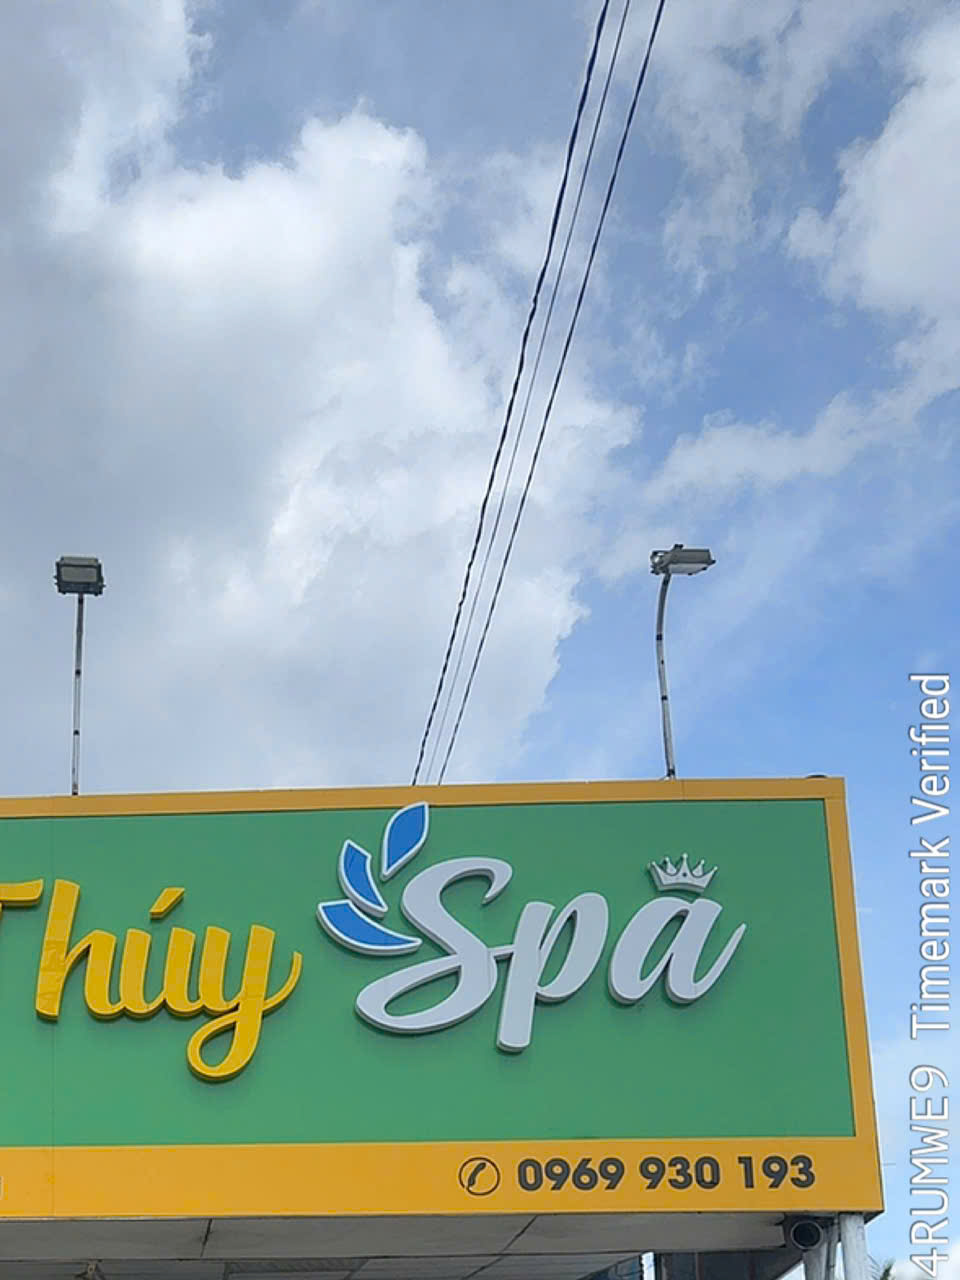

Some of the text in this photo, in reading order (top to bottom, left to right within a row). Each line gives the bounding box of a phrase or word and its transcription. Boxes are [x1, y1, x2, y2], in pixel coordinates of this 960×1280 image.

[355, 856, 747, 1053] Spa
[517, 1155, 816, 1191] 0969 930 193
